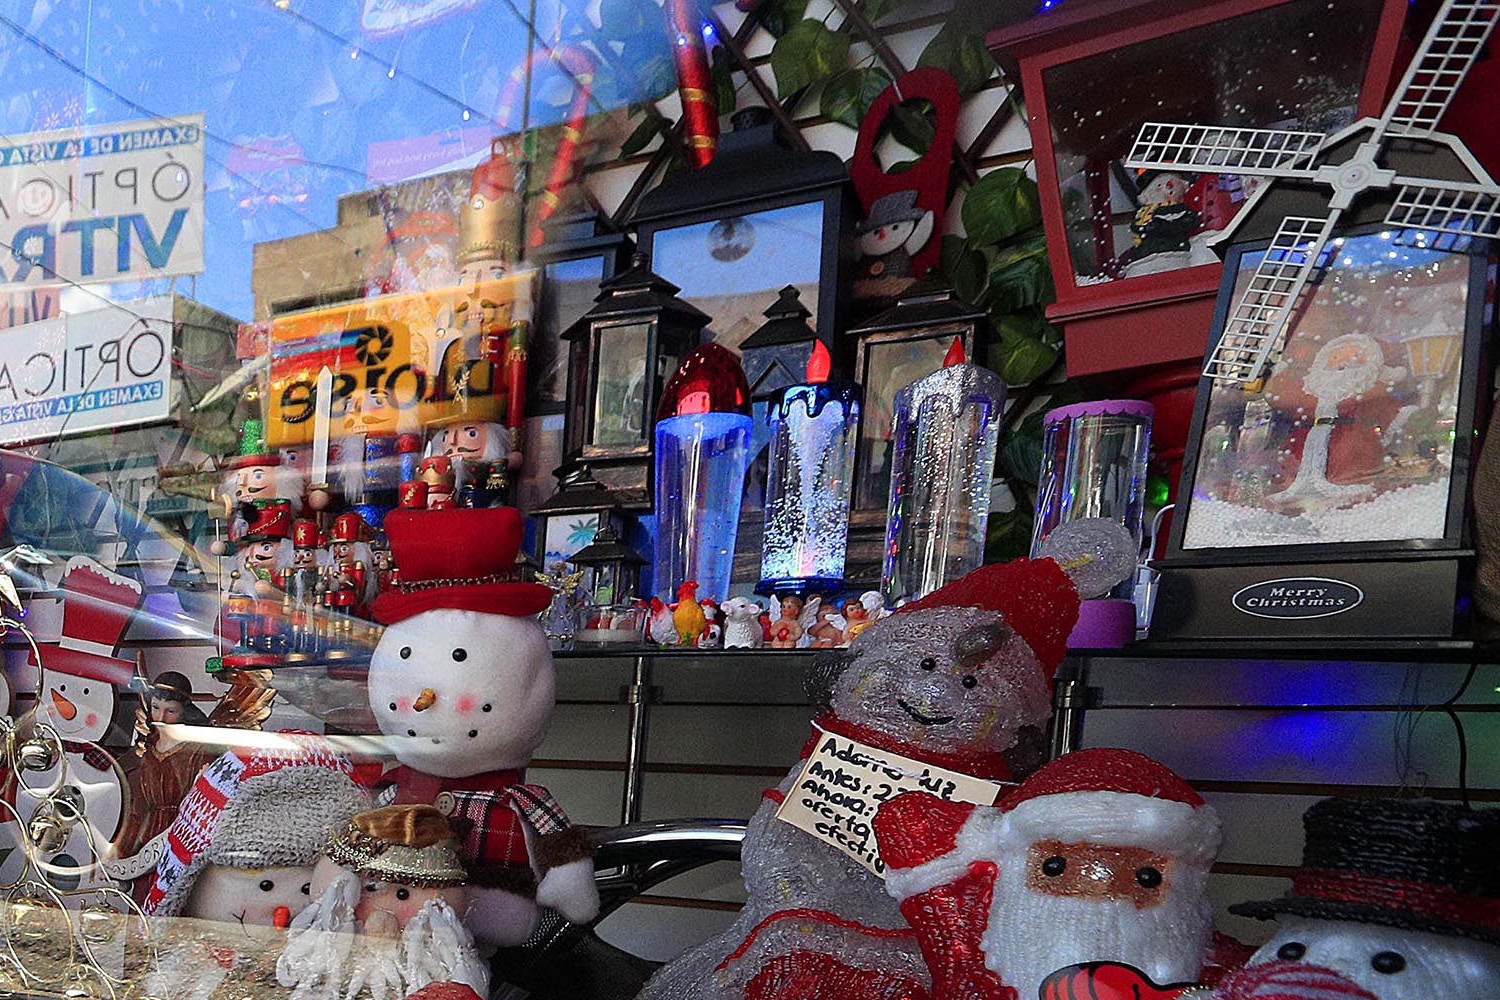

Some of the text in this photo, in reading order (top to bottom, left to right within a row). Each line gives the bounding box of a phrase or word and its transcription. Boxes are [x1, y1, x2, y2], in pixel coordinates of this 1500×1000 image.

[1269, 586, 1329, 601] Merry
[1245, 596, 1347, 609] Christmas
[800, 779, 876, 817] Ahora:
